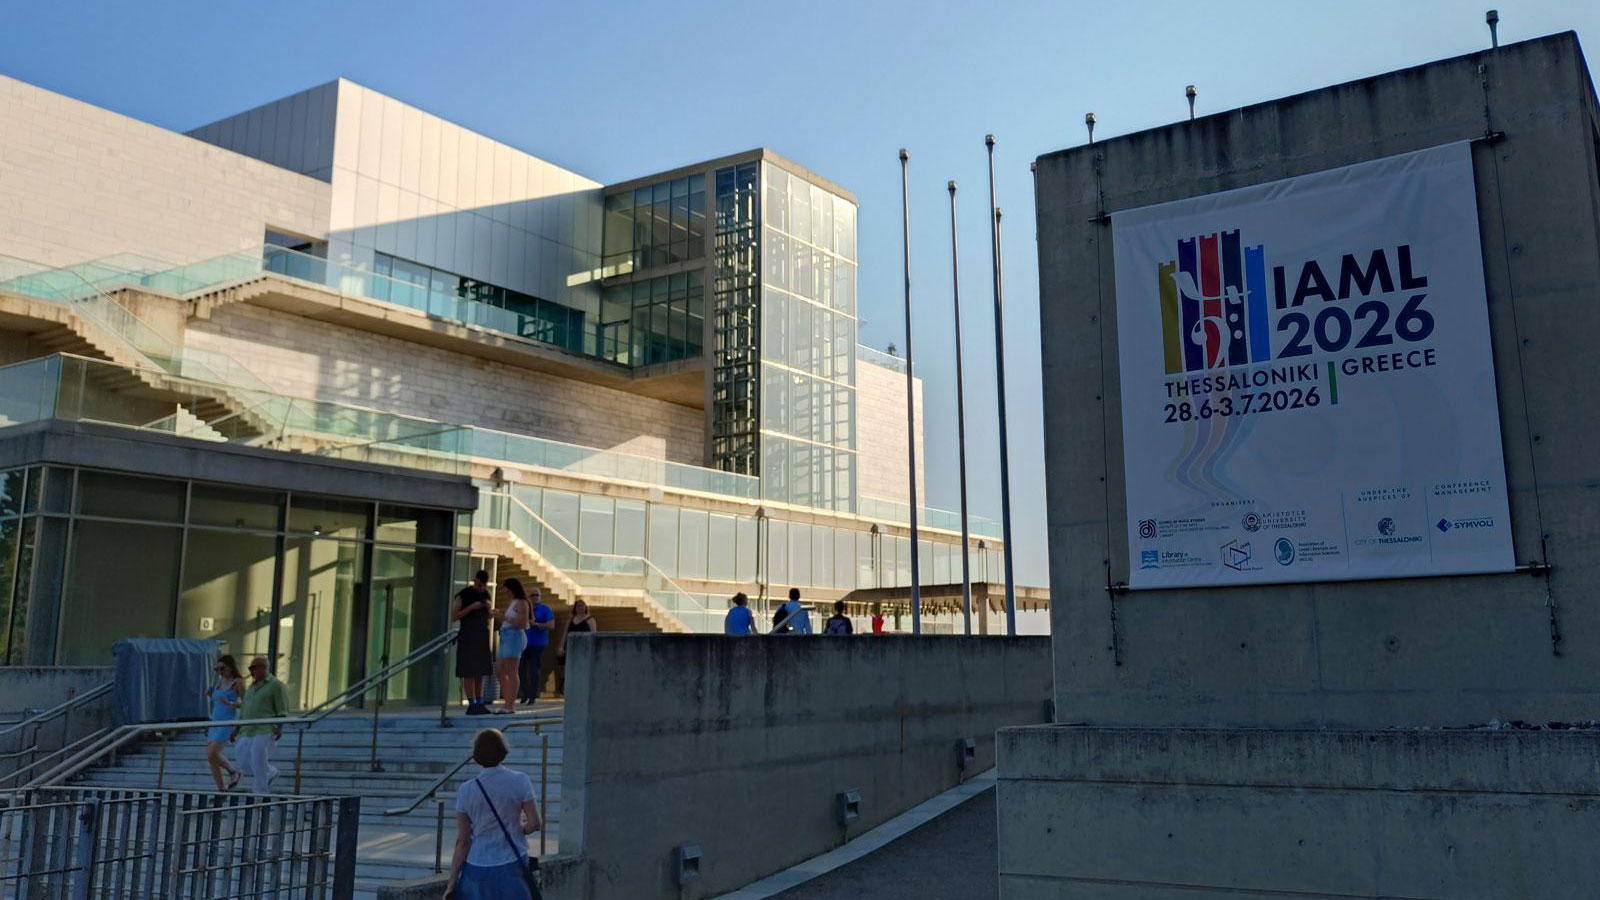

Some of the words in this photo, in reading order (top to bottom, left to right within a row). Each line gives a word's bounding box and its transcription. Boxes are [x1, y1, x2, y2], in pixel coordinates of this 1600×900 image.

[1273, 244, 1428, 310] IAML
[1276, 294, 1435, 359] 2026
[1164, 363, 1319, 398] THESSALONIKI
[1341, 349, 1437, 376] GREECE
[1164, 386, 1321, 423] 28.6-3.7.2026
[1435, 481, 1489, 490] CONFERENCE
[1435, 487, 1491, 496] MANAGEMENT
[1454, 520, 1494, 529] SYMVOLI
[1161, 551, 1184, 560] Library
